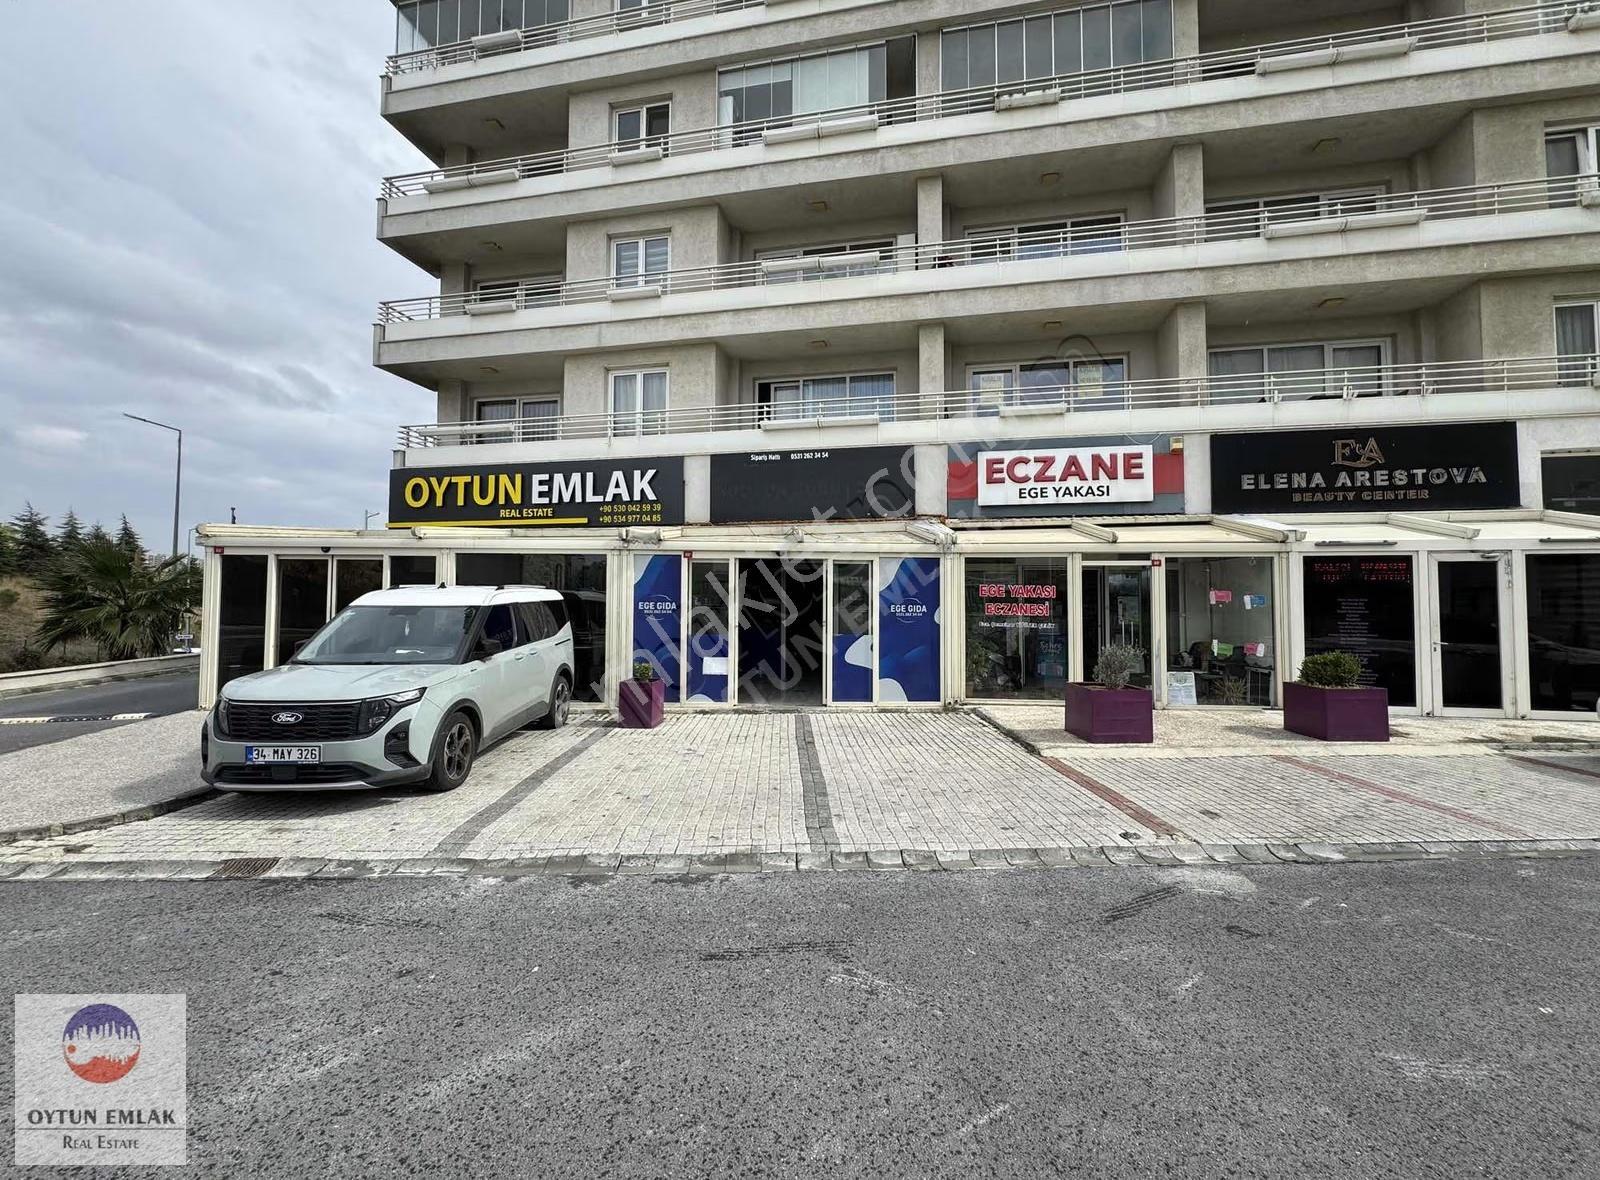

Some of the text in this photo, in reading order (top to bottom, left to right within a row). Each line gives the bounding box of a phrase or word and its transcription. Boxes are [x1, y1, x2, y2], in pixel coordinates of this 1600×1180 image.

[985, 452, 1145, 485] ECZANE
[1241, 466, 1488, 490] ELENA ARESTOVA
[404, 468, 658, 508] OYTUN EMLAK
[1018, 485, 1111, 499] EGE YAKASI
[1361, 489, 1430, 501] CENTER
[500, 508, 553, 518] REAL ESTATE
[600, 503, 662, 513] +90 530 042 59 39
[613, 515, 627, 523] 534
[627, 514, 641, 522] 977
[642, 514, 651, 522] 04
[978, 584, 1057, 599] EGE YAKASI
[638, 602, 677, 610] EGE GIDA
[890, 604, 927, 612] EGE GIDA
[984, 601, 1050, 616] ECZANESİ
[277, 713, 297, 722] Ford
[254, 748, 317, 760] 34 MAY 326
